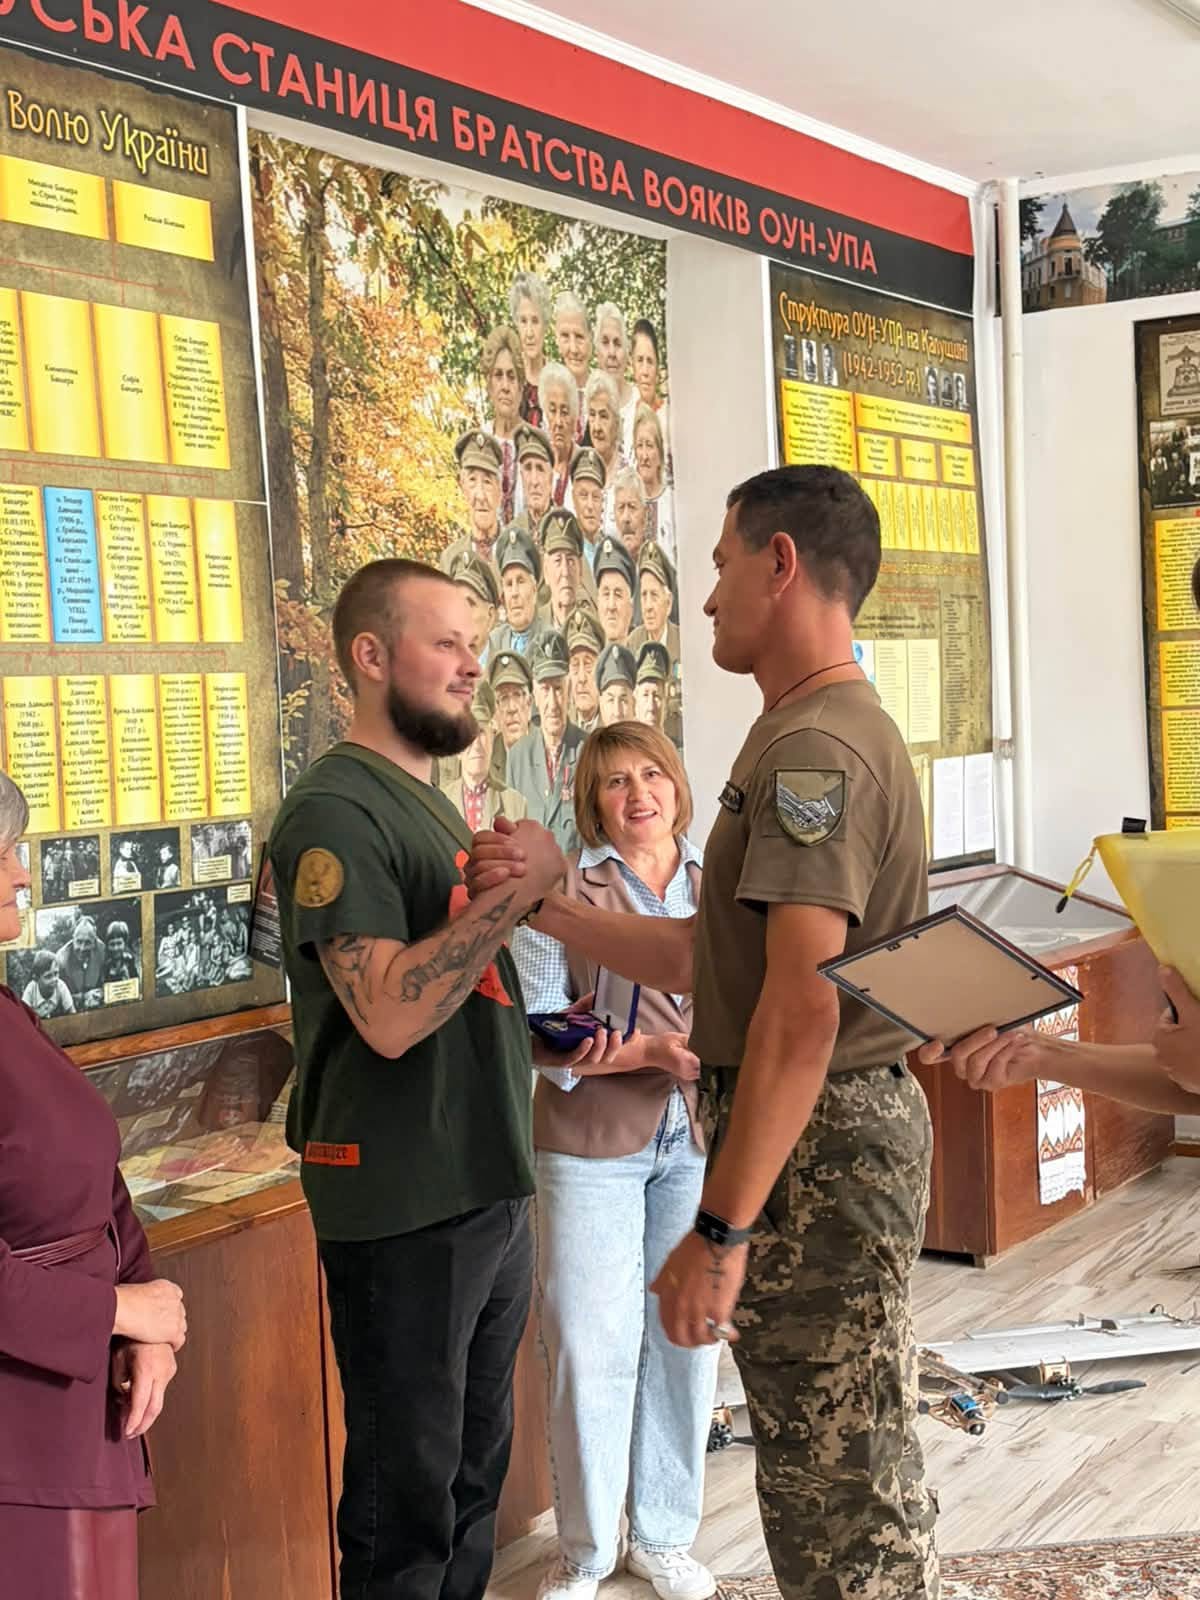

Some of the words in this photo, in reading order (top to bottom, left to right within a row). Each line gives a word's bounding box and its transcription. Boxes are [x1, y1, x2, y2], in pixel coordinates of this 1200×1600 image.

[8, 90, 90, 145] Волю
[100, 110, 208, 175] України
[212, 32, 438, 142] СТАНИЦЯ
[452, 106, 635, 201] БРАТСТВА
[643, 168, 750, 235] ВОЯКІВ
[759, 207, 878, 274] ОУН-УПА
[779, 291, 849, 341] Структура
[852, 311, 903, 353] ОУН-УПА
[906, 330, 919, 350] на
[842, 351, 904, 386] (1942-1952
